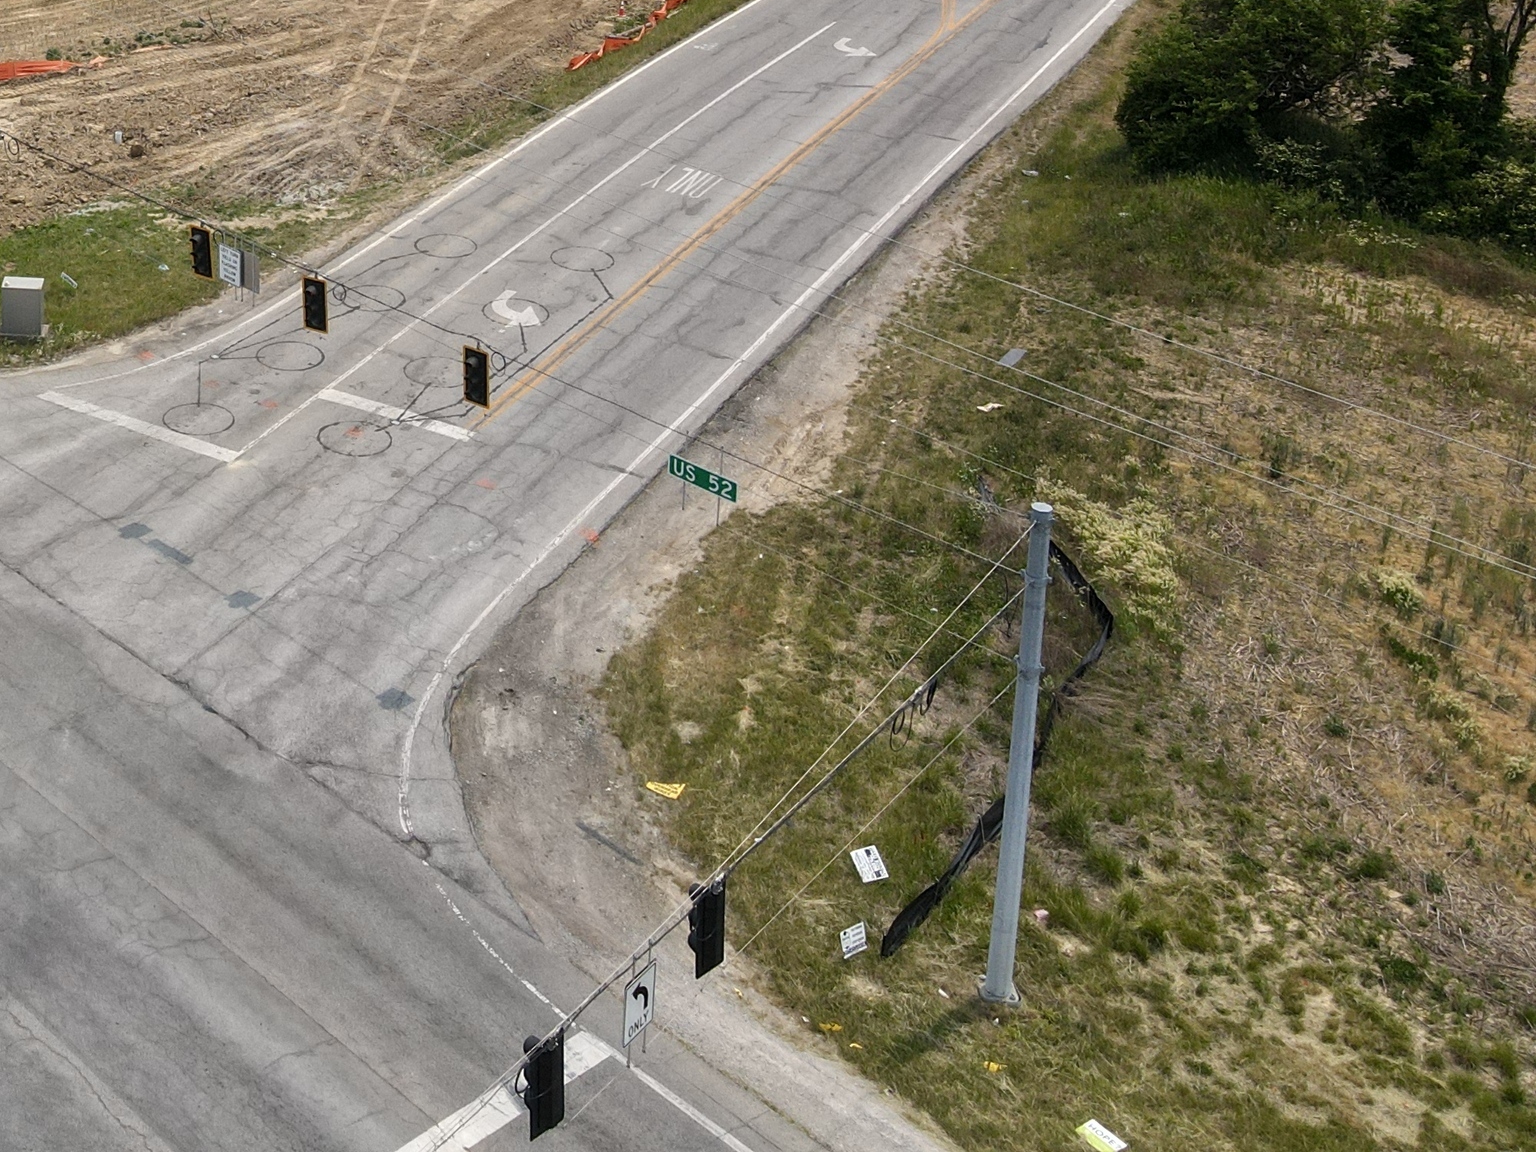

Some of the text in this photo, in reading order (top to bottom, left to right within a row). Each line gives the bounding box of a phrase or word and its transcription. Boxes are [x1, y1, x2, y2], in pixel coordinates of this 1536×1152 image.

[640, 164, 724, 199] ONLY
[673, 458, 732, 499] US 52
[628, 1009, 650, 1038] ONLY
